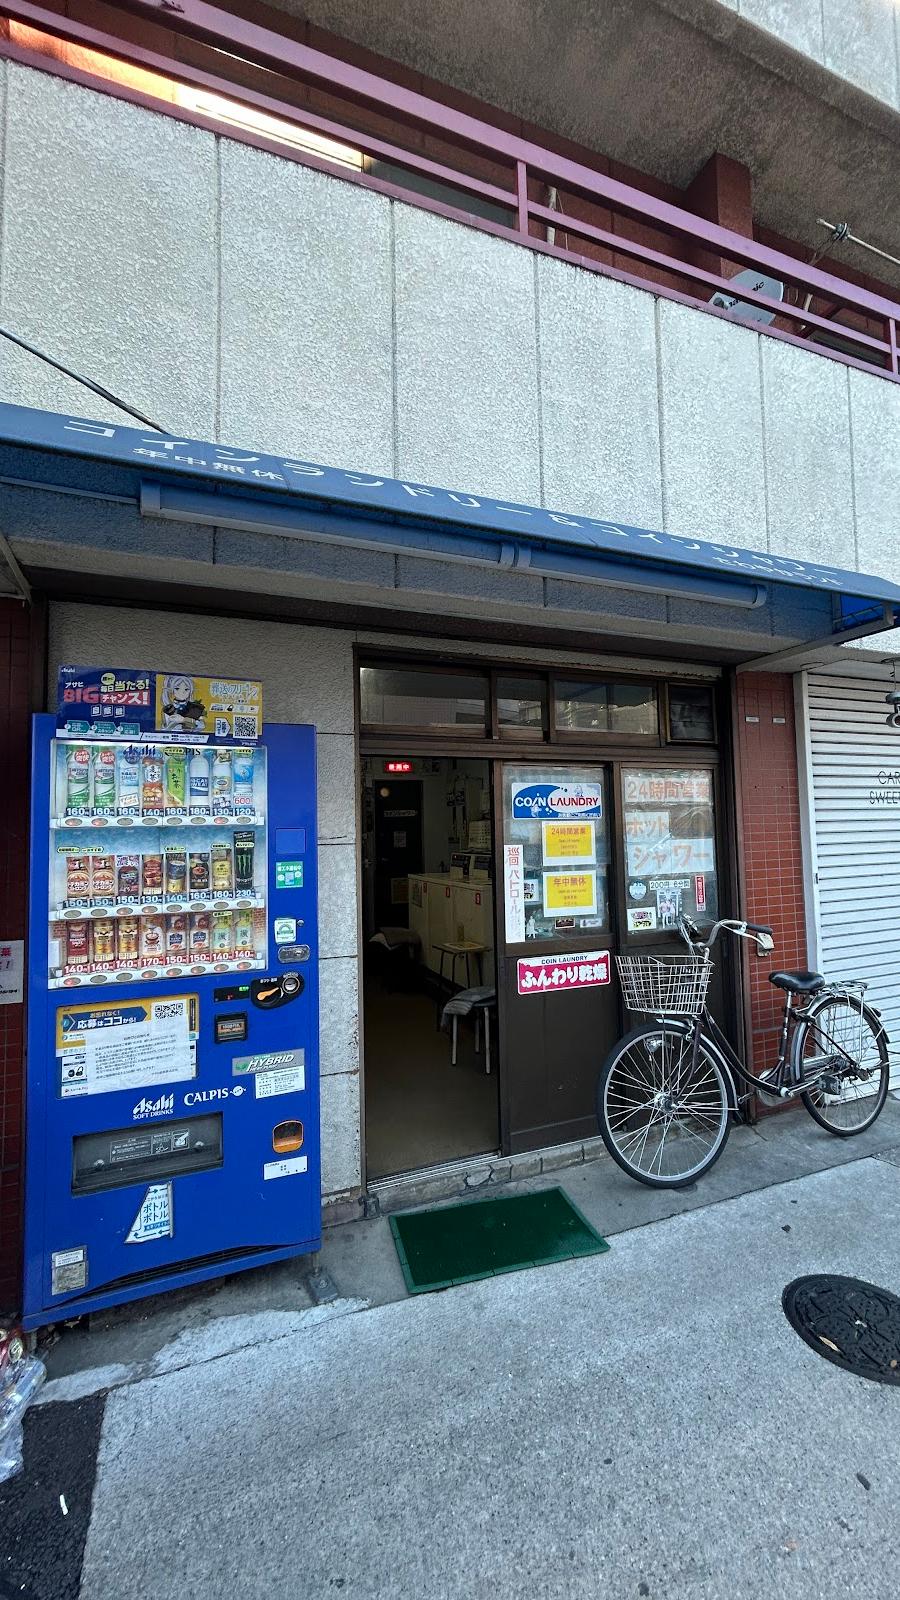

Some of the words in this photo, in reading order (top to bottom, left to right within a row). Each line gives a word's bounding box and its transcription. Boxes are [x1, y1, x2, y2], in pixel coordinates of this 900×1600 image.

[133, 447, 284, 482] 年中無休
[64, 686, 100, 704] BIG
[515, 796, 546, 807] COIN
[550, 797, 598, 806] LAUNDRY
[627, 816, 665, 837] ホット
[633, 844, 710, 870] シャワー
[554, 876, 586, 886] 年中無休
[558, 955, 588, 963] LAUNDRY
[521, 963, 607, 988] ふんわり乾燥
[77, 1016, 137, 1030] 応募はココから!
[246, 1054, 294, 1072] HYBRID
[133, 1092, 174, 1115] Asahi
[184, 1087, 229, 1106] CALPIS
[133, 1112, 150, 1121] SOFT
[150, 1109, 174, 1118] DRINKS
[143, 1201, 169, 1214] ボトル
[143, 1210, 169, 1224] ボトル
